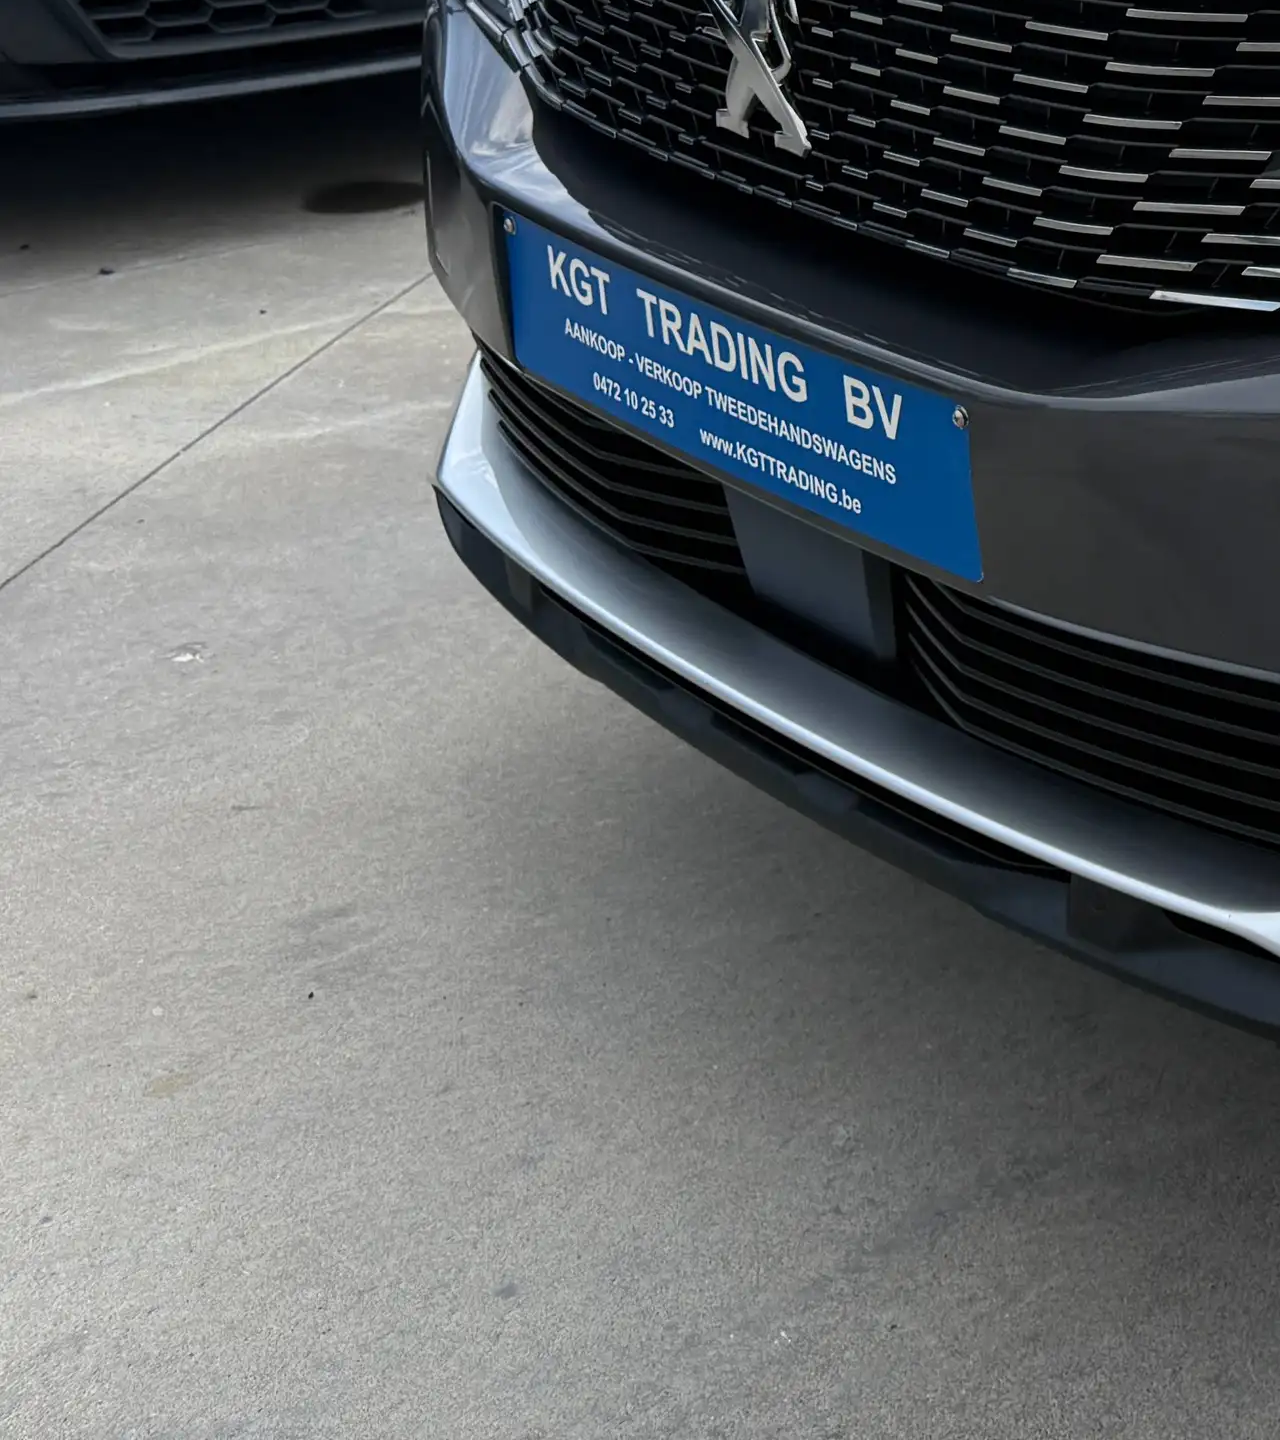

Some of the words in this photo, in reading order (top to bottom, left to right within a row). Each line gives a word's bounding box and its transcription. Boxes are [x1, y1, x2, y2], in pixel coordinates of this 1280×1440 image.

[546, 244, 611, 316] KGT
[635, 287, 808, 403] TRADING
[842, 373, 903, 441] BV
[564, 317, 626, 362] AANKOOP
[634, 352, 702, 400] VERKOOP
[704, 385, 897, 485] TWEEDEHANDSWAGENS
[593, 371, 622, 402] 0472
[624, 388, 639, 411] 10
[641, 396, 657, 420] 25
[659, 405, 675, 429] 33
[699, 428, 862, 514] www.KGTTRADING.be
